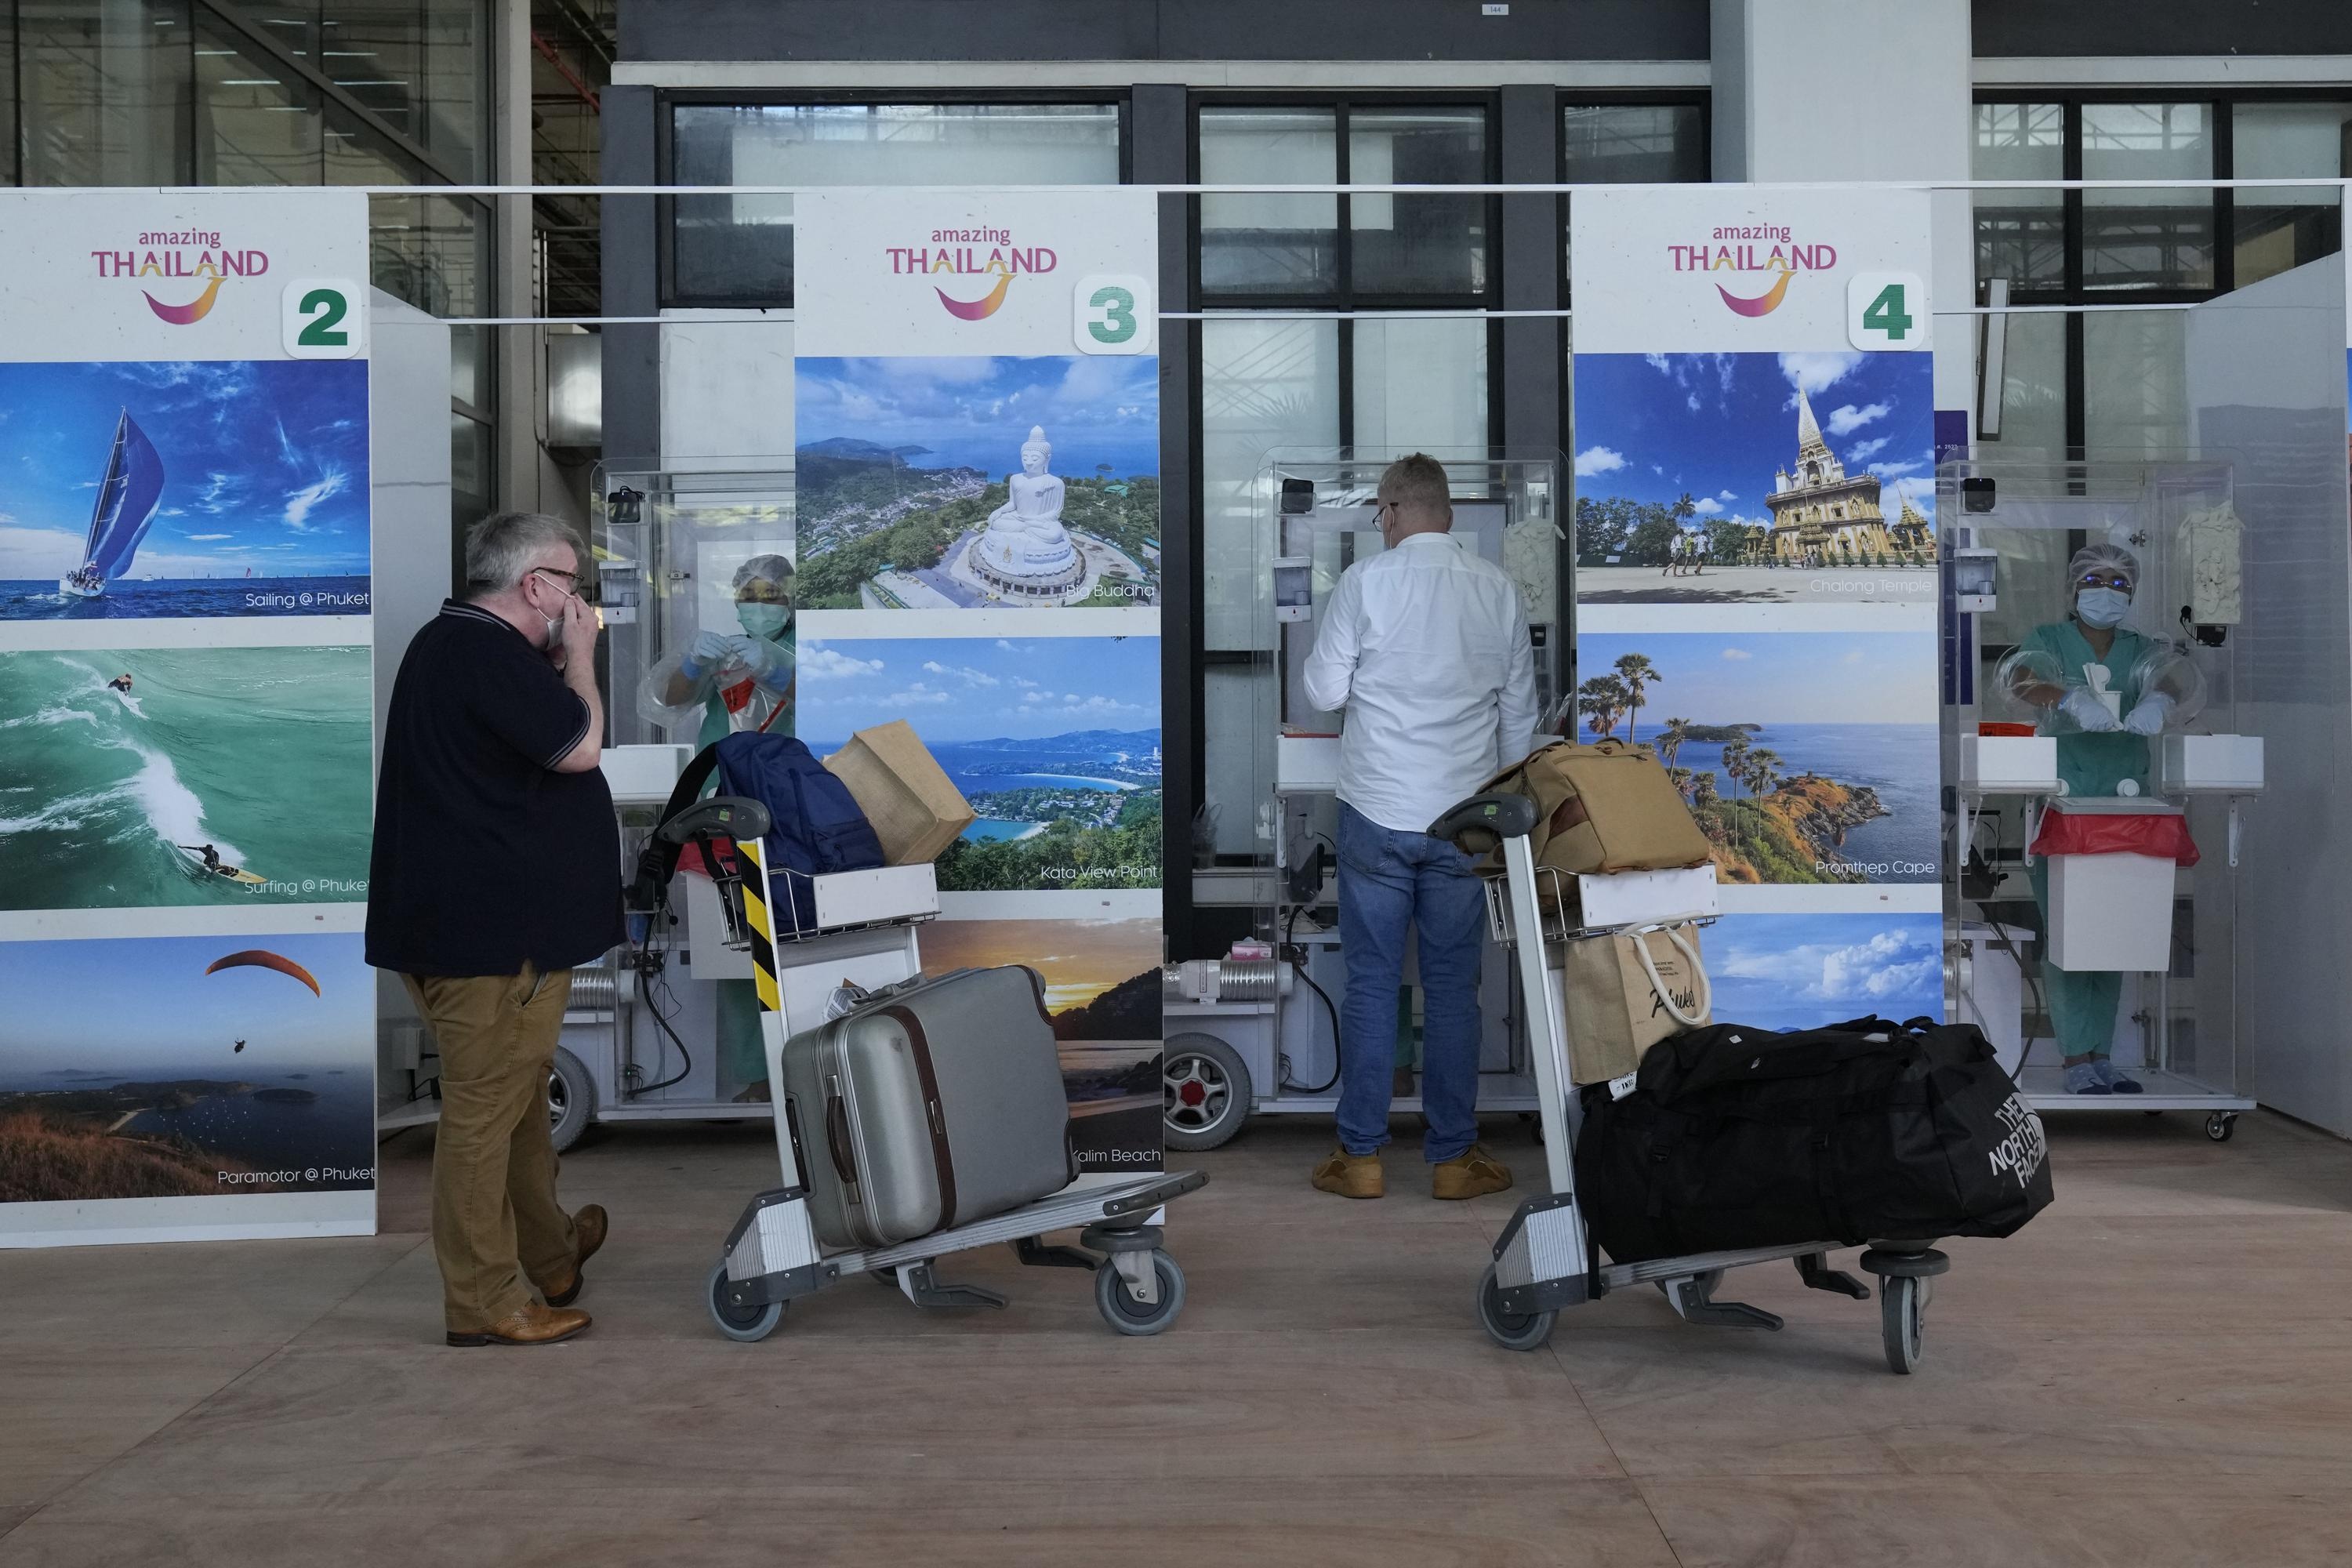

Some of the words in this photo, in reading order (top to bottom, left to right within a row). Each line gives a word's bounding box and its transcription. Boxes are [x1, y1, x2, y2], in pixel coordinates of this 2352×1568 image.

[138, 227, 221, 249] amazing
[931, 225, 1011, 246] amazing
[1712, 223, 1791, 243] amazing
[91, 250, 270, 278] THAILAND
[885, 248, 1057, 274] THAILAND
[1667, 245, 1837, 271] THAILAND
[297, 289, 348, 346] 2
[1087, 286, 1137, 343] 3
[1863, 284, 1913, 340] 4
[1066, 584, 1090, 599] Big
[1094, 584, 1155, 597] Buddha
[1810, 579, 1875, 595] Chalong
[1878, 579, 1933, 593] Temple
[245, 593, 296, 608] Sailing
[299, 592, 313, 606] @
[317, 592, 369, 605] Phuket
[1041, 866, 1076, 879] Kata
[1080, 865, 1116, 878] View
[1120, 865, 1158, 878] Point
[1816, 861, 1889, 876] Promthep
[1893, 860, 1936, 876] Cape
[245, 880, 297, 895] Surfing
[302, 879, 315, 892] @
[320, 878, 369, 892] Phuke
[1994, 1094, 2025, 1131] THE
[1073, 1149, 1107, 1162] alim
[1112, 1149, 1161, 1162] Beach
[1988, 1116, 2037, 1177] NORTH
[218, 1170, 301, 1184] Paramotor
[305, 1167, 318, 1181] @
[322, 1167, 375, 1181] Phuket
[2013, 1141, 2042, 1189] FACE
